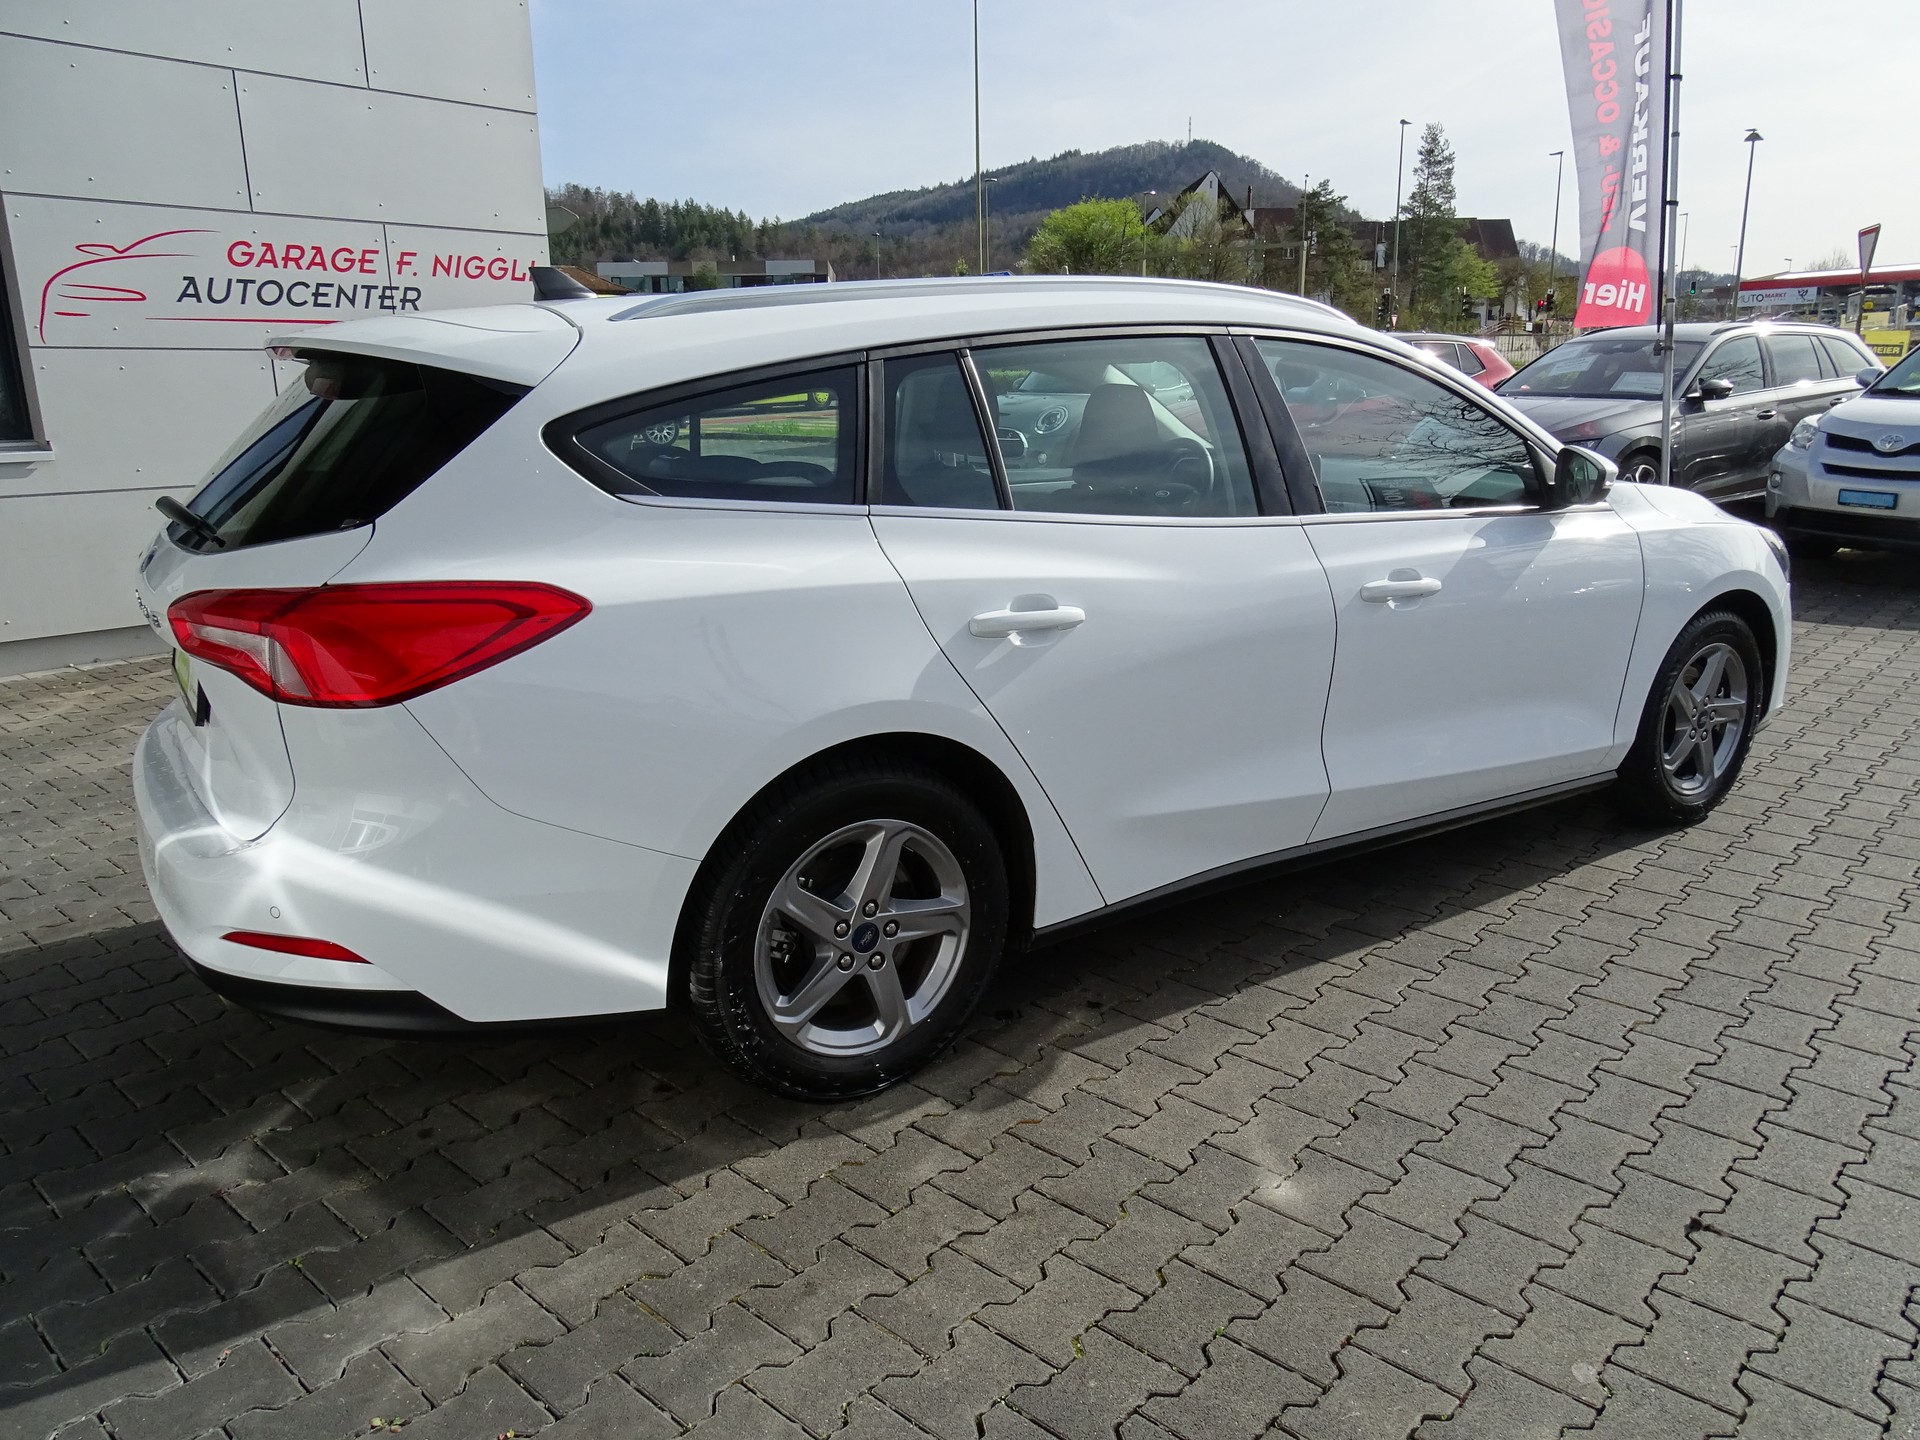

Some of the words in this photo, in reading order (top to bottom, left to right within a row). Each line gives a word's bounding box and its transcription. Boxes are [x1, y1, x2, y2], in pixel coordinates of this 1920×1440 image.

[226, 240, 380, 274] GARAGE
[396, 251, 418, 277] F.
[175, 275, 422, 312] AUTOCENTER
